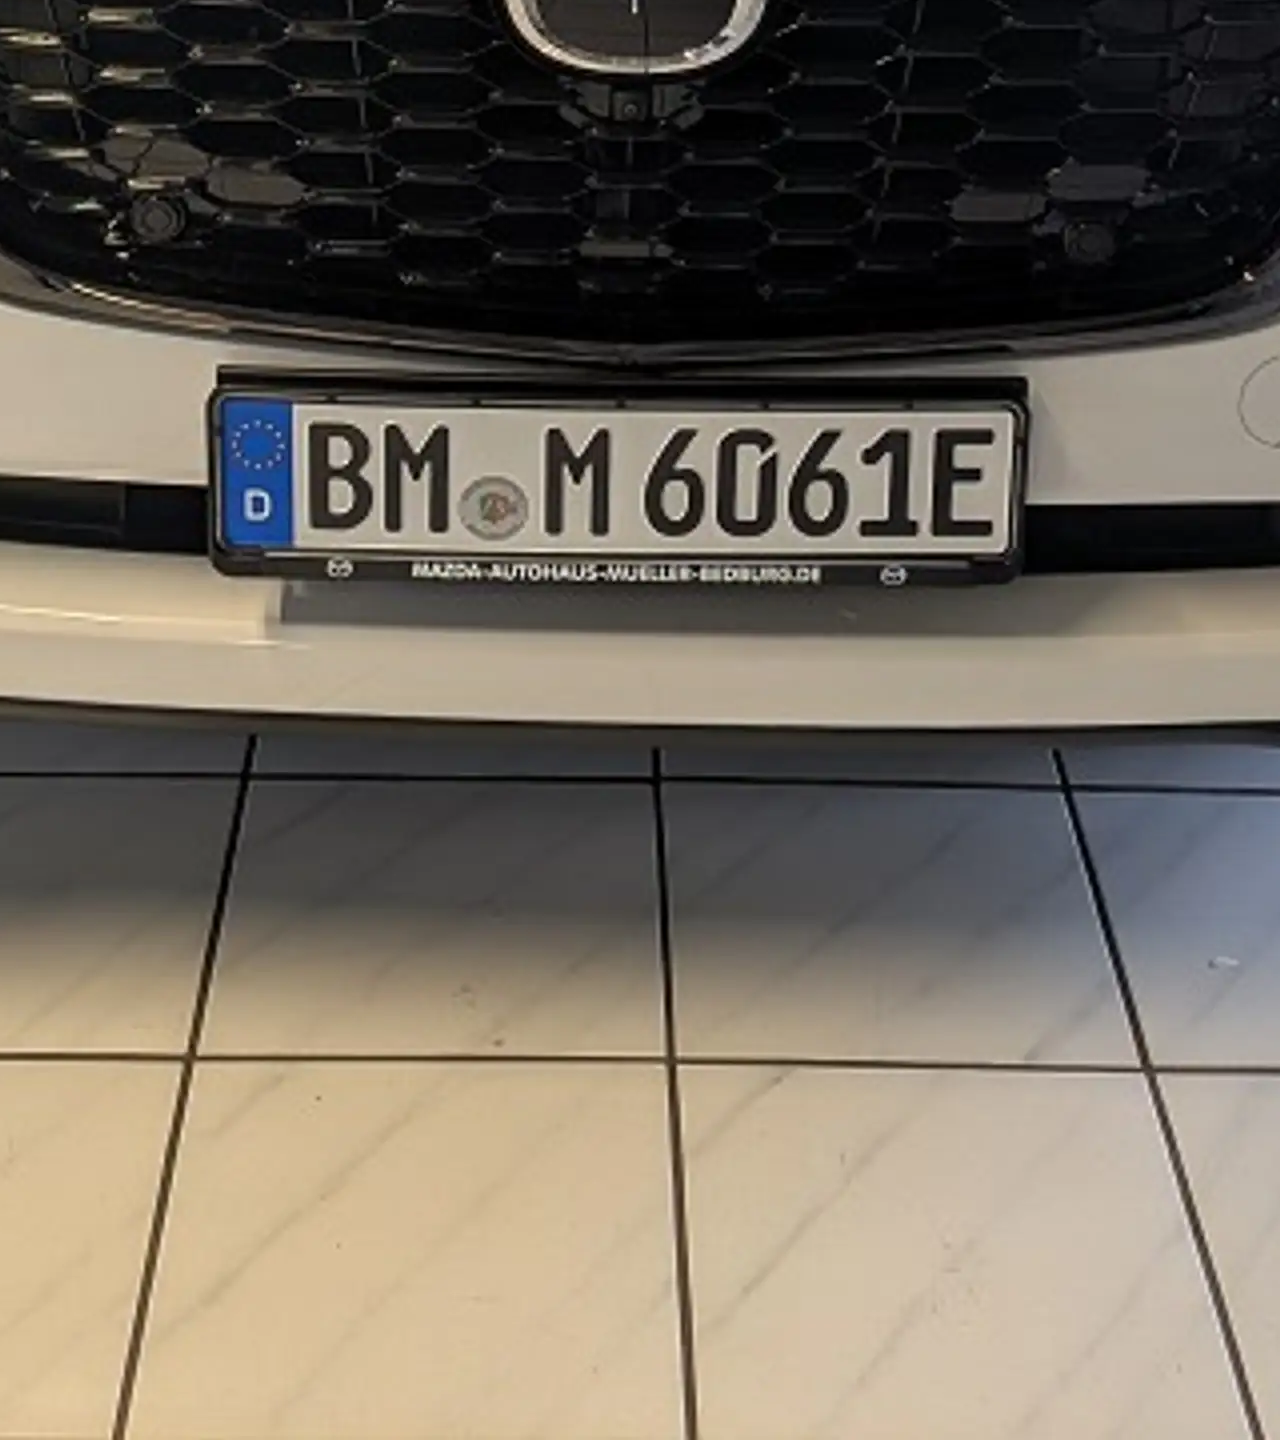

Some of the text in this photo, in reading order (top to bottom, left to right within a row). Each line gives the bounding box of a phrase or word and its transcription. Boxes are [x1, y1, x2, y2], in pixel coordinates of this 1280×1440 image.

[244, 487, 273, 523] D
[307, 423, 994, 539] BM M 6061E
